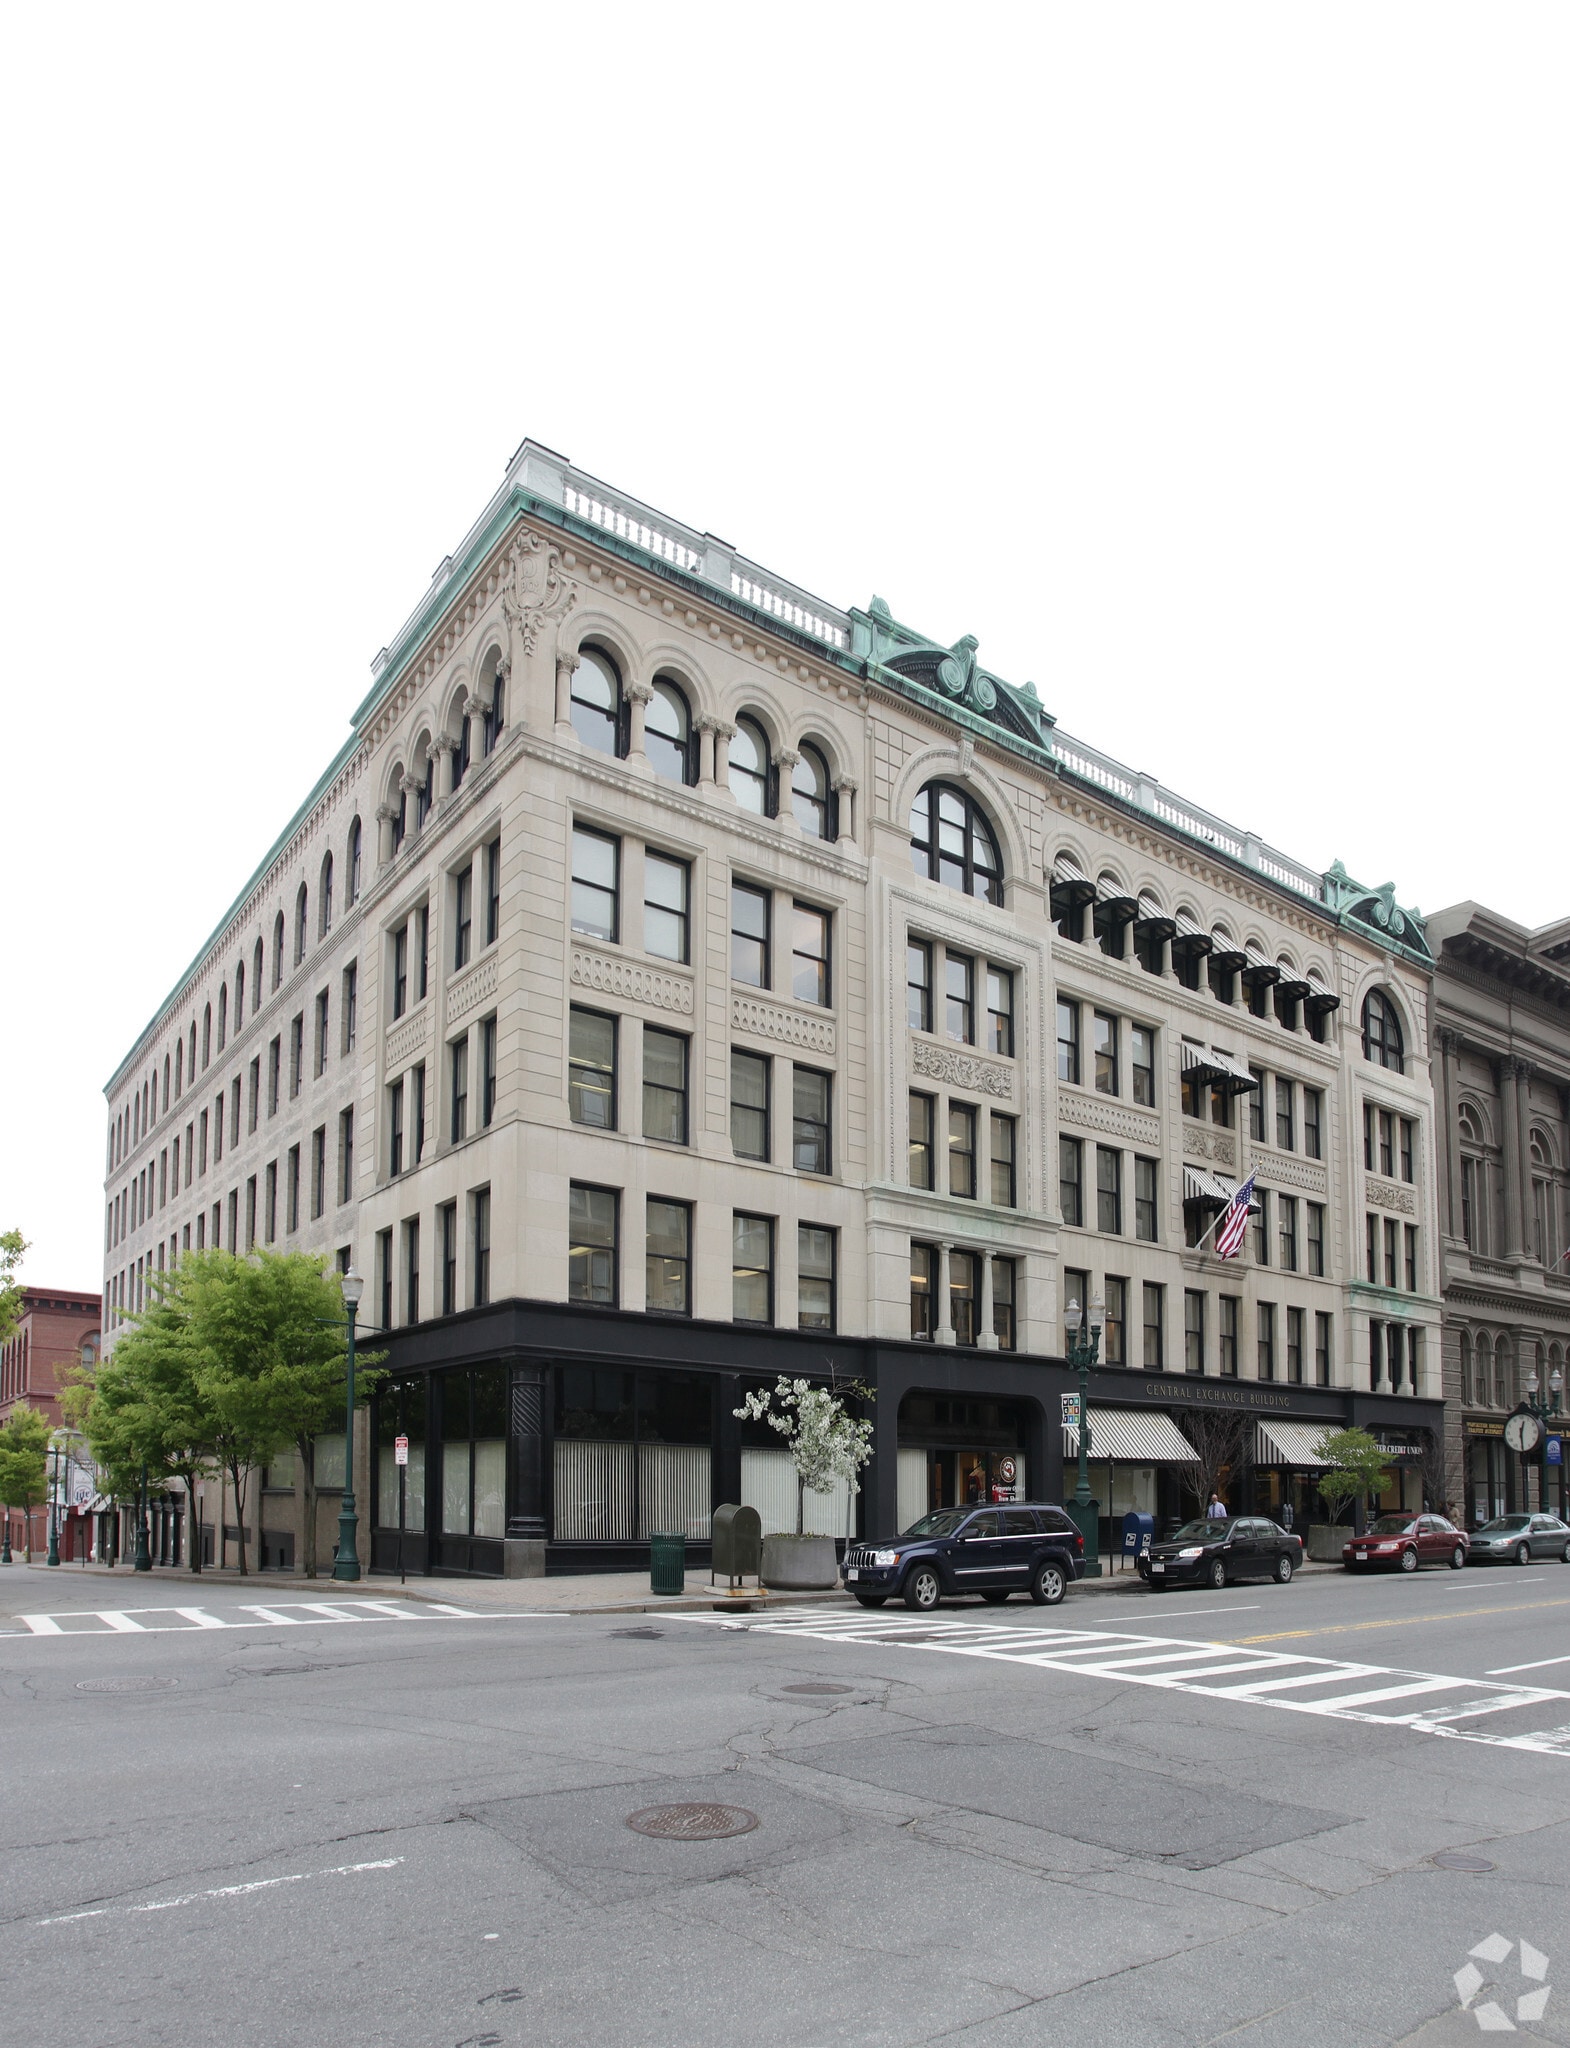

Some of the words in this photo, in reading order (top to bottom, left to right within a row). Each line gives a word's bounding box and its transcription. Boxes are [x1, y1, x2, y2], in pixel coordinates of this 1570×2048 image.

[1146, 1384, 1191, 1398] CENTRAL
[1196, 1389, 1245, 1403] EXCHANGE
[1250, 1394, 1290, 1407] BUILDING
[1387, 1445, 1406, 1454] CREDIT
[1407, 1446, 1423, 1455] UNION
